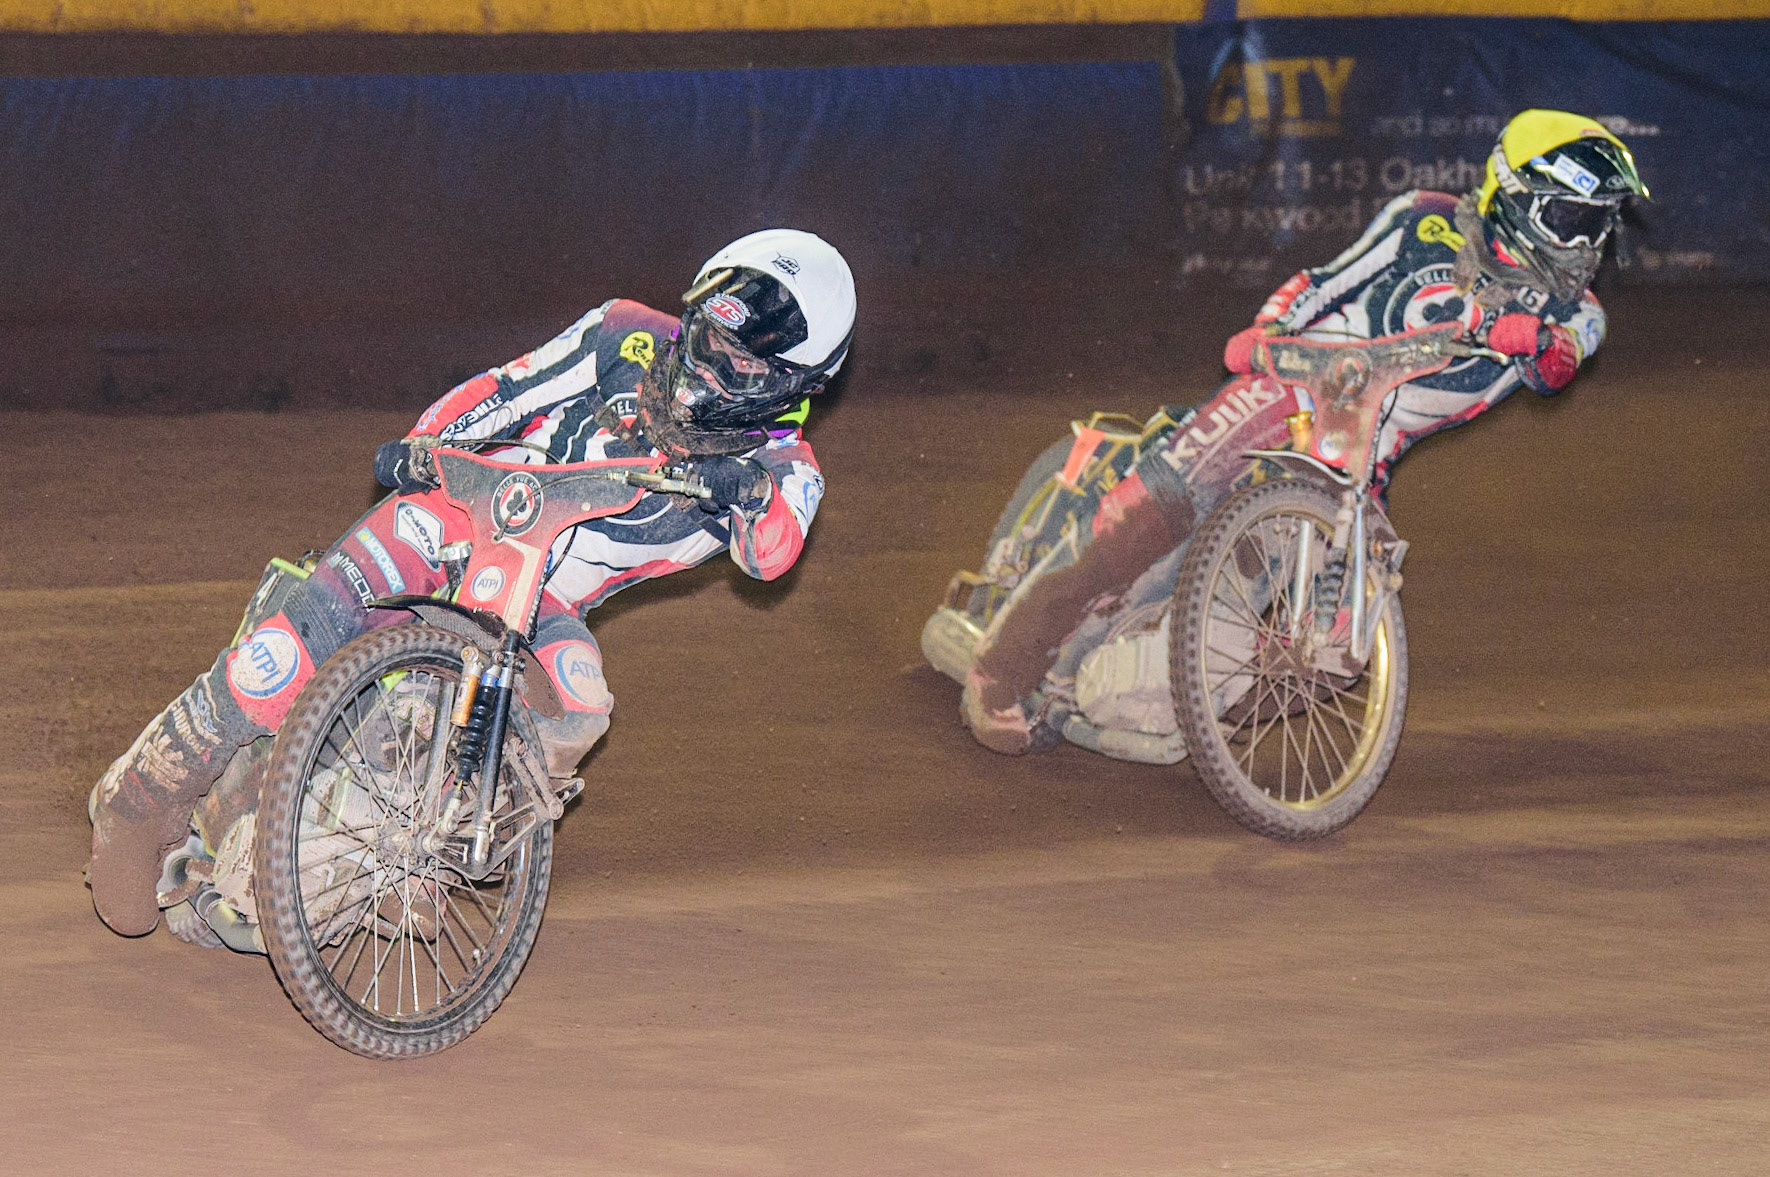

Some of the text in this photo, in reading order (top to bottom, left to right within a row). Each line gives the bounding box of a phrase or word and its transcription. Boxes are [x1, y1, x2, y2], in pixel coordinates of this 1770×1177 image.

[709, 298, 743, 322] STS
[366, 537, 404, 591] MOTOREX
[476, 577, 500, 591] ATPI
[250, 640, 282, 684] ATPI
